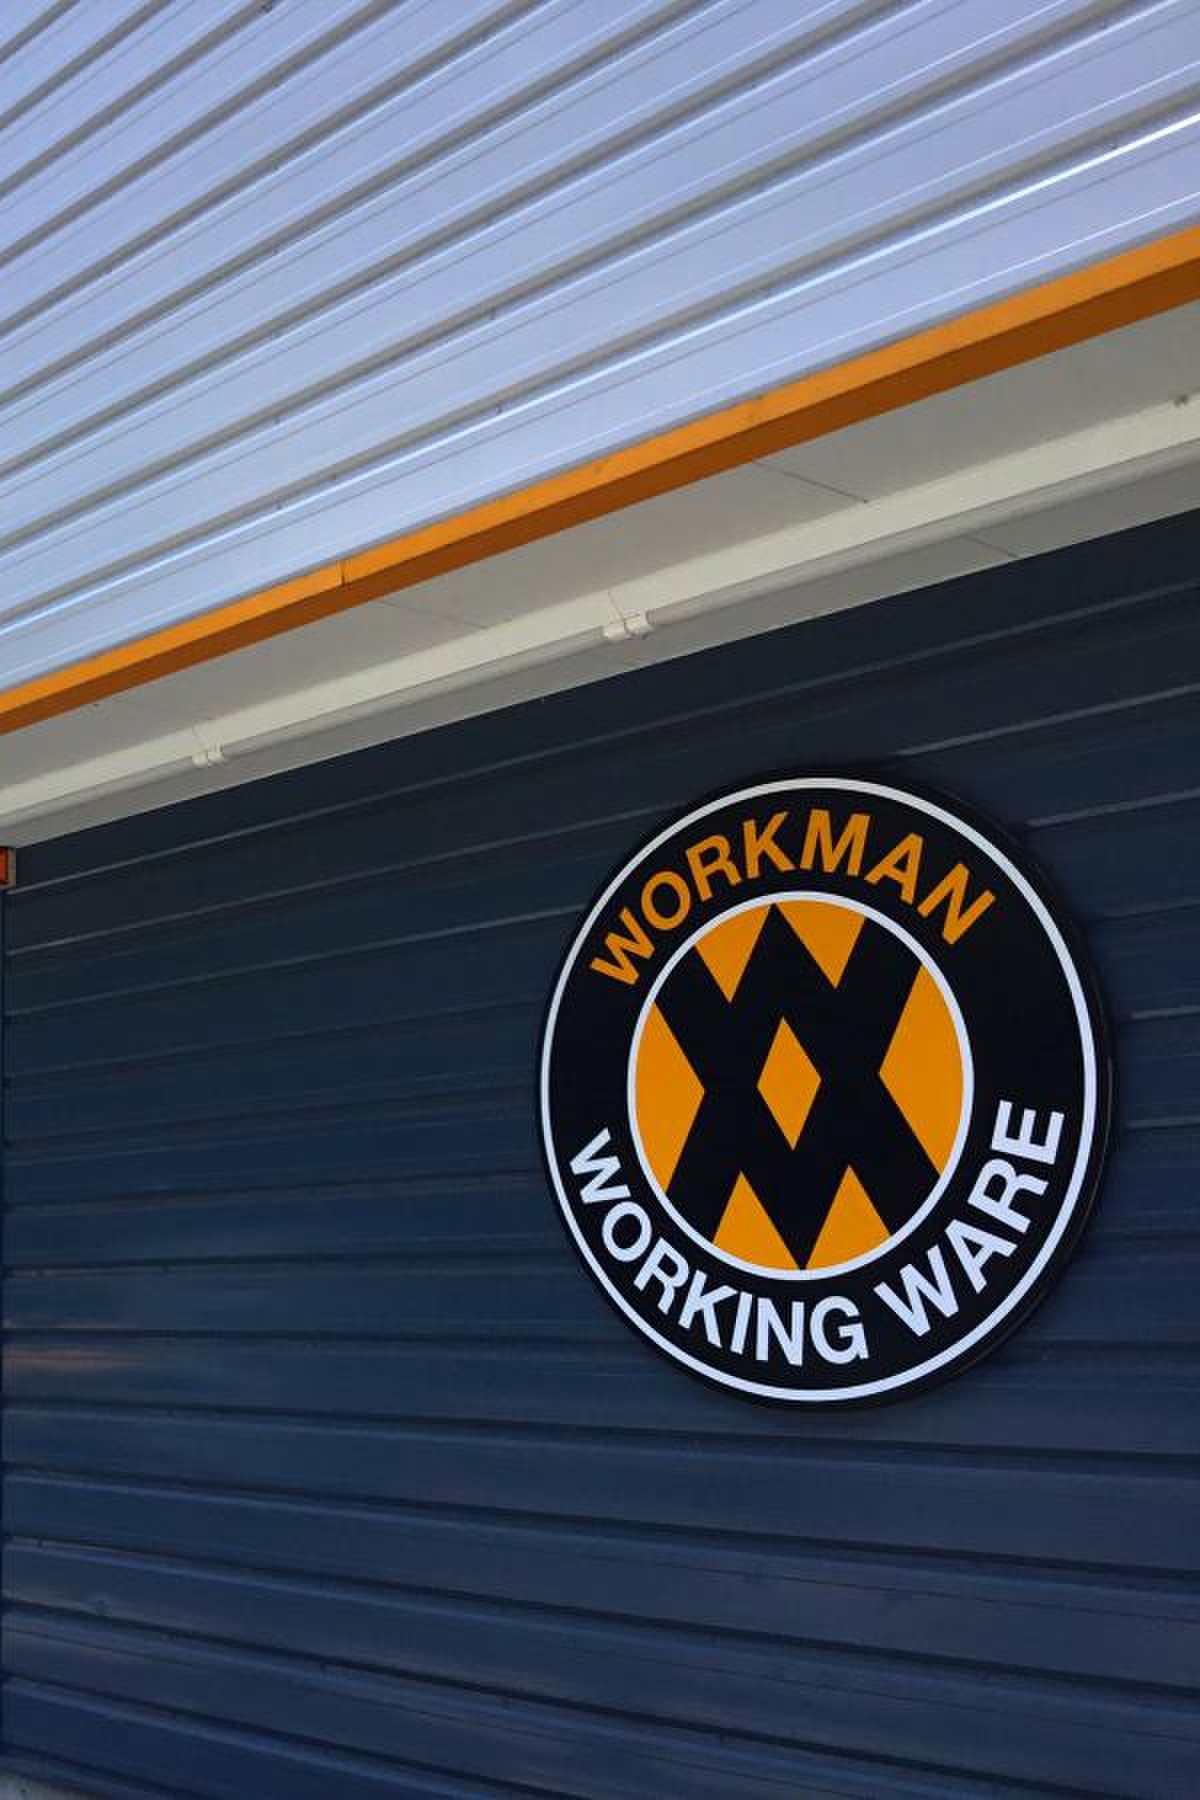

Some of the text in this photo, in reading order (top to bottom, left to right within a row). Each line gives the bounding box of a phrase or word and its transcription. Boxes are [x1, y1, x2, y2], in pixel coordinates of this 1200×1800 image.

[590, 808, 996, 986] WORKMAN
[568, 1100, 1065, 1366] WORKING WARE
